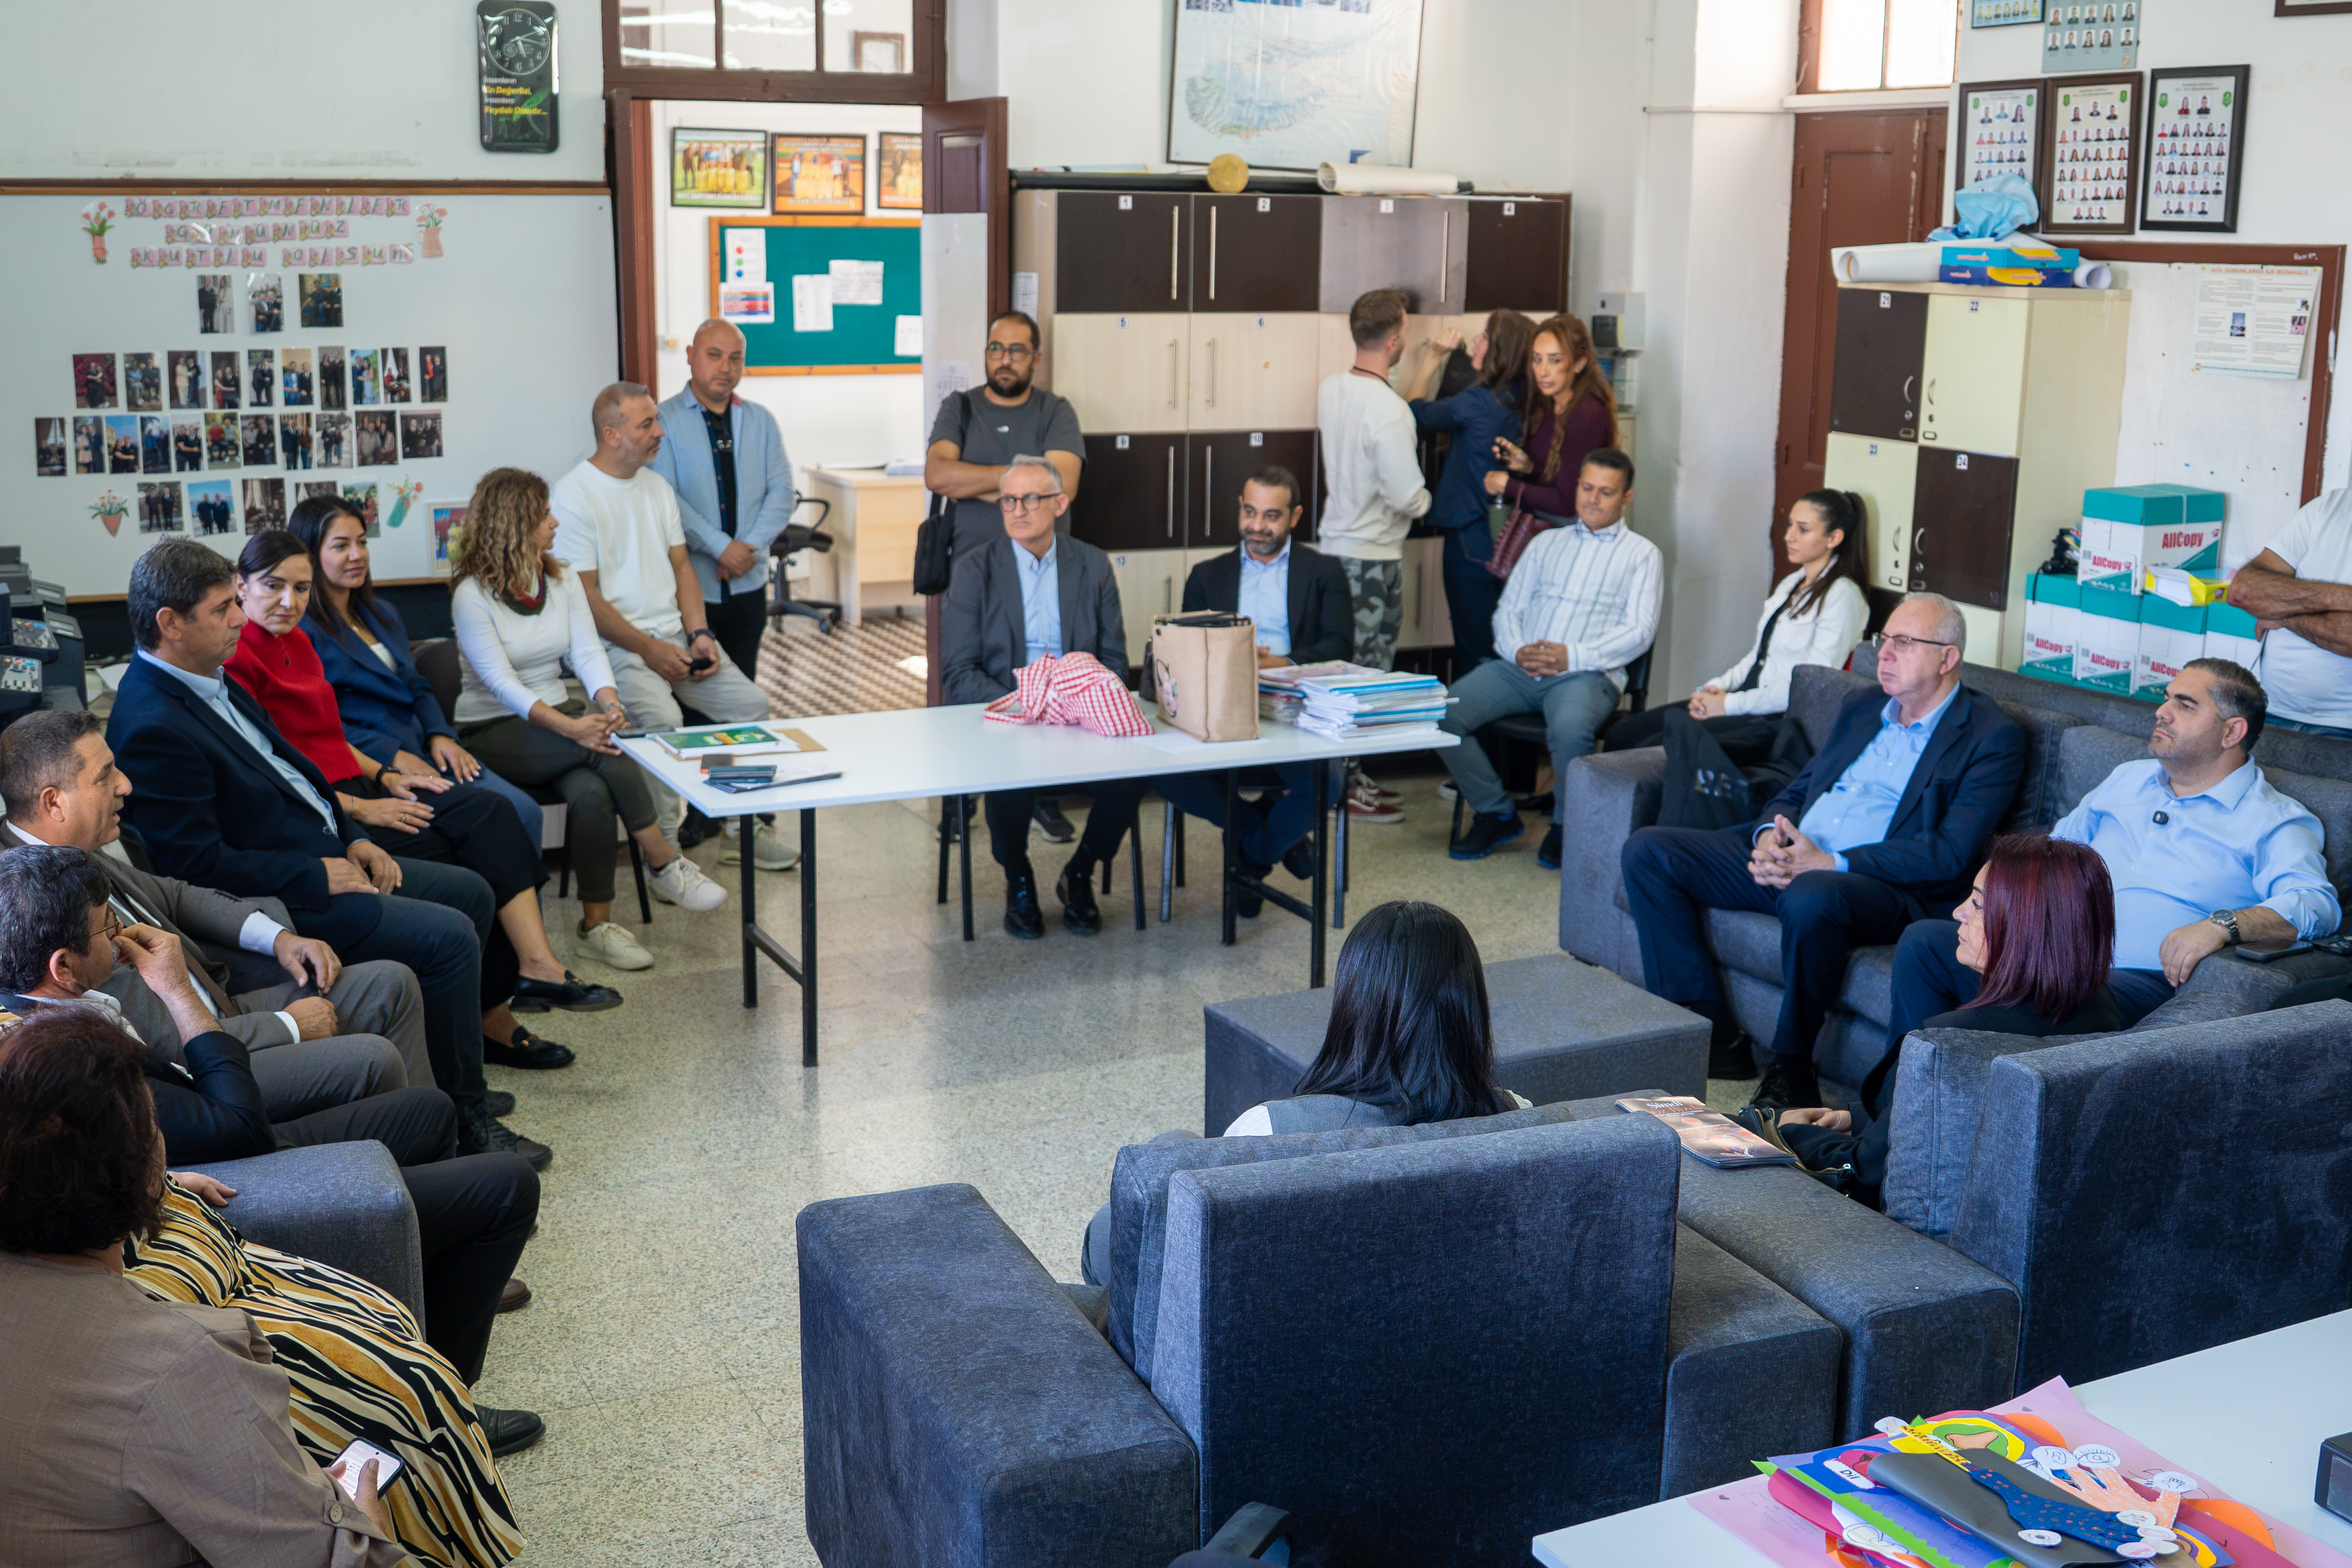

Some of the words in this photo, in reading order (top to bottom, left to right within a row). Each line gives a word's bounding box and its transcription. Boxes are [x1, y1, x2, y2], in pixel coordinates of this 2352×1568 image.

[2162, 531, 2203, 549] AllCopy
[2092, 555, 2122, 571] AllCopy
[2035, 637, 2063, 653] AllCopy
[2090, 653, 2121, 670] AllCopy
[1840, 1469, 1860, 1479] Dil
